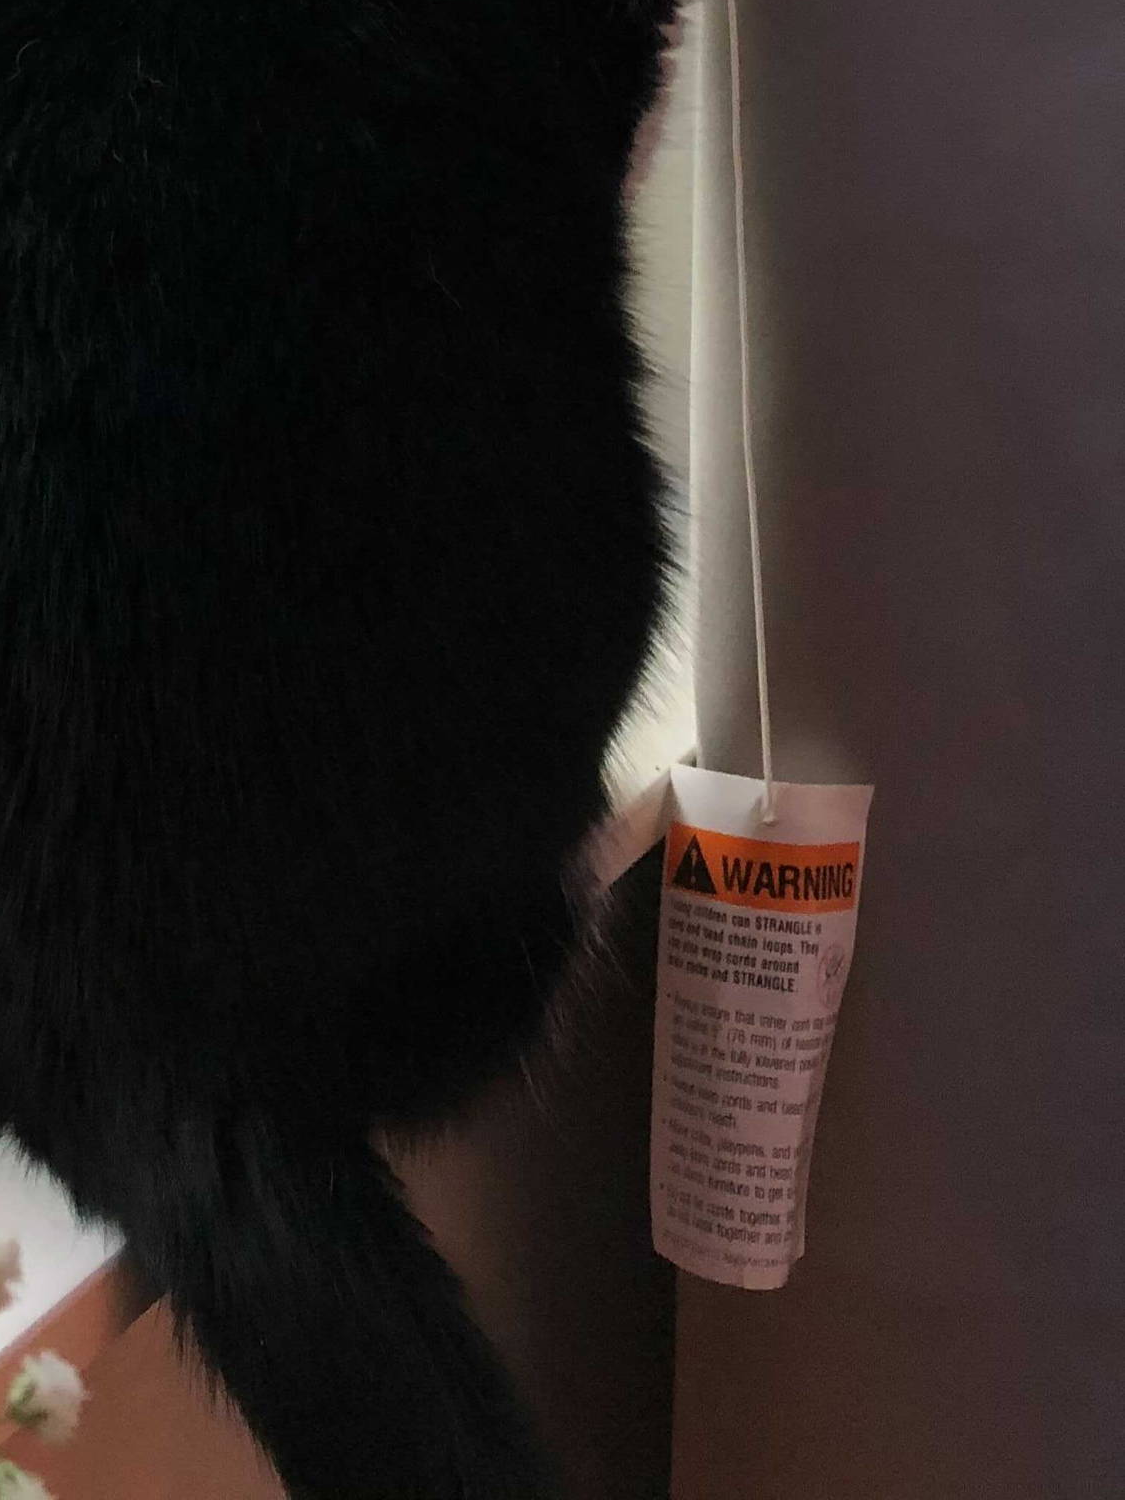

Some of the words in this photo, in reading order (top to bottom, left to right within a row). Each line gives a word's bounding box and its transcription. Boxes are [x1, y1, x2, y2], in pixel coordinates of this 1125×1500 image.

[722, 854, 854, 902] WARNING
[731, 915, 751, 929] can
[755, 916, 813, 936] STRANGLE
[725, 953, 757, 968] cords
[760, 959, 800, 975] around
[756, 1100, 778, 1114] and
[772, 1145, 791, 1160] and
[745, 1164, 767, 1179] and
